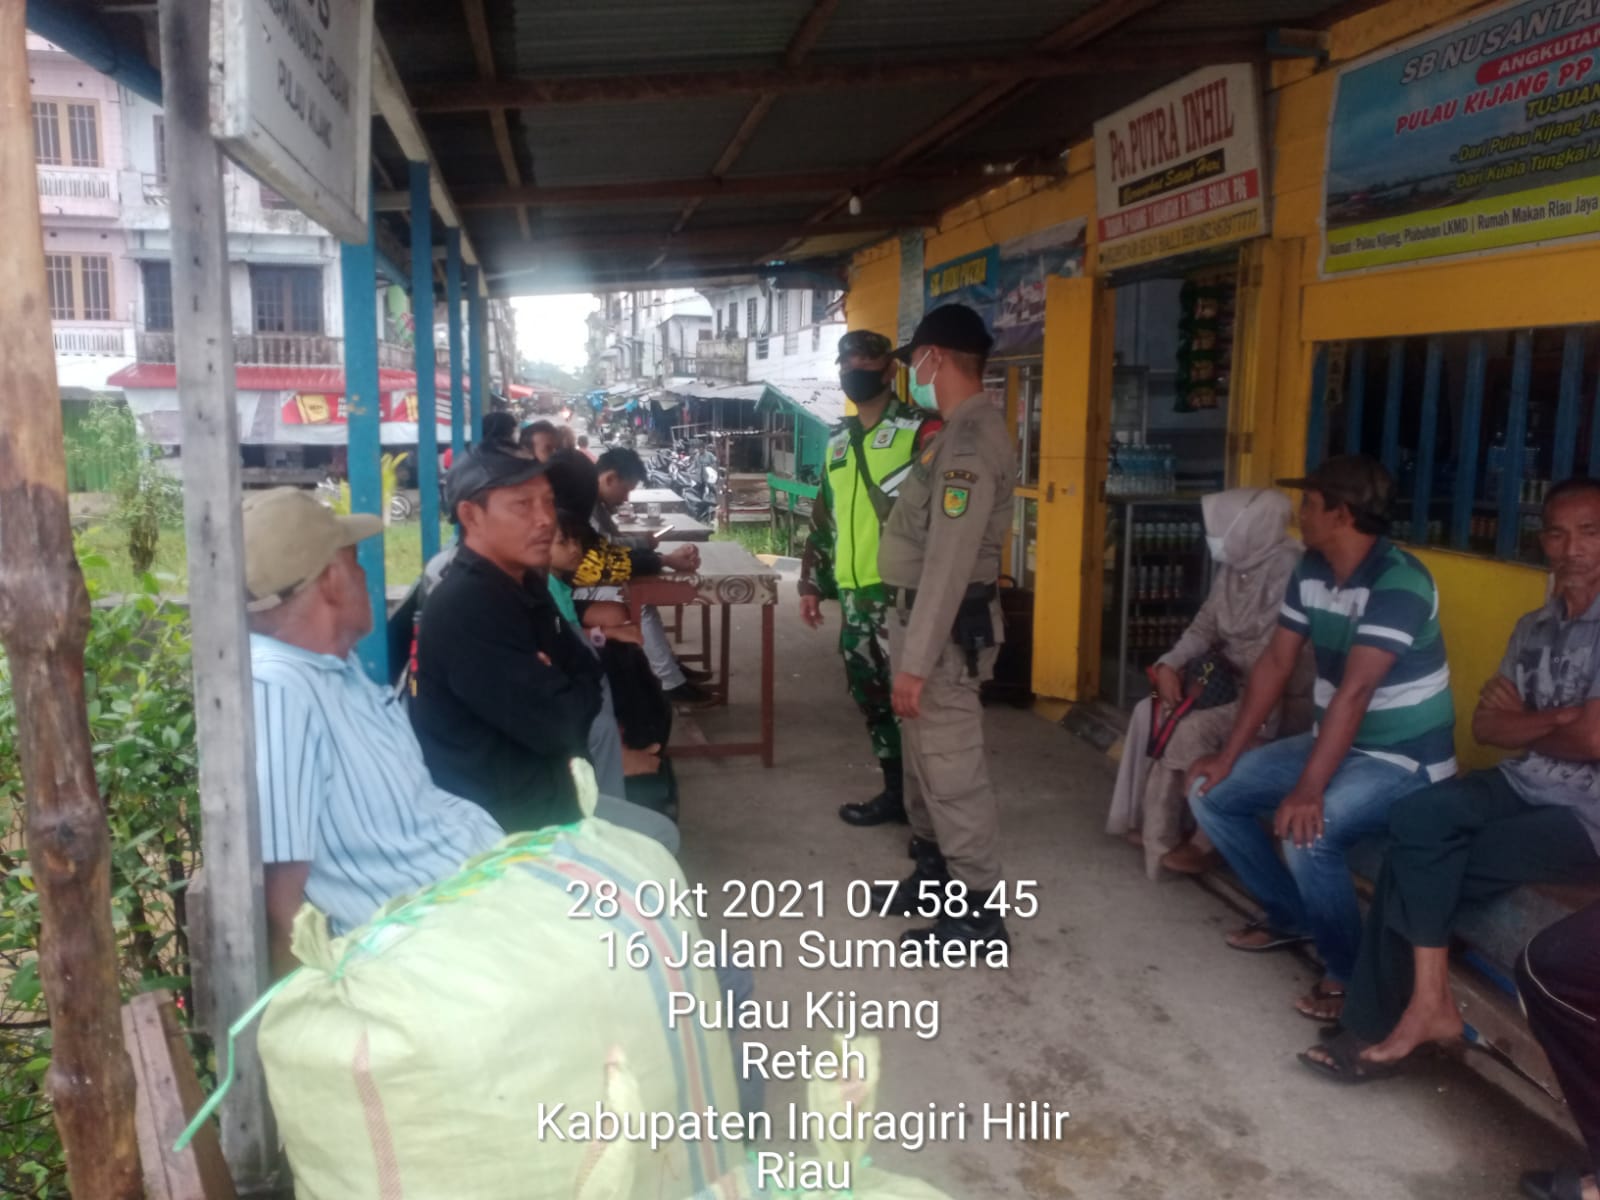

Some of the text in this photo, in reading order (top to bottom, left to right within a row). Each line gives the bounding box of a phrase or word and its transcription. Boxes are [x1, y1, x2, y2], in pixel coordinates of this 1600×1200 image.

[1401, 52, 1437, 84] SB
[1182, 77, 1234, 152] INHIL
[1396, 56, 1593, 134] PULAU KIJANG PP
[1490, 131, 1529, 153] Pulau
[1534, 117, 1584, 141] Kijang
[1487, 161, 1526, 182] Kuala
[1530, 144, 1591, 172] Tungkal
[1443, 217, 1468, 236] LKMD
[1479, 209, 1510, 230] Rumah
[1512, 206, 1545, 224] Makan
[1573, 195, 1599, 215] Jaya
